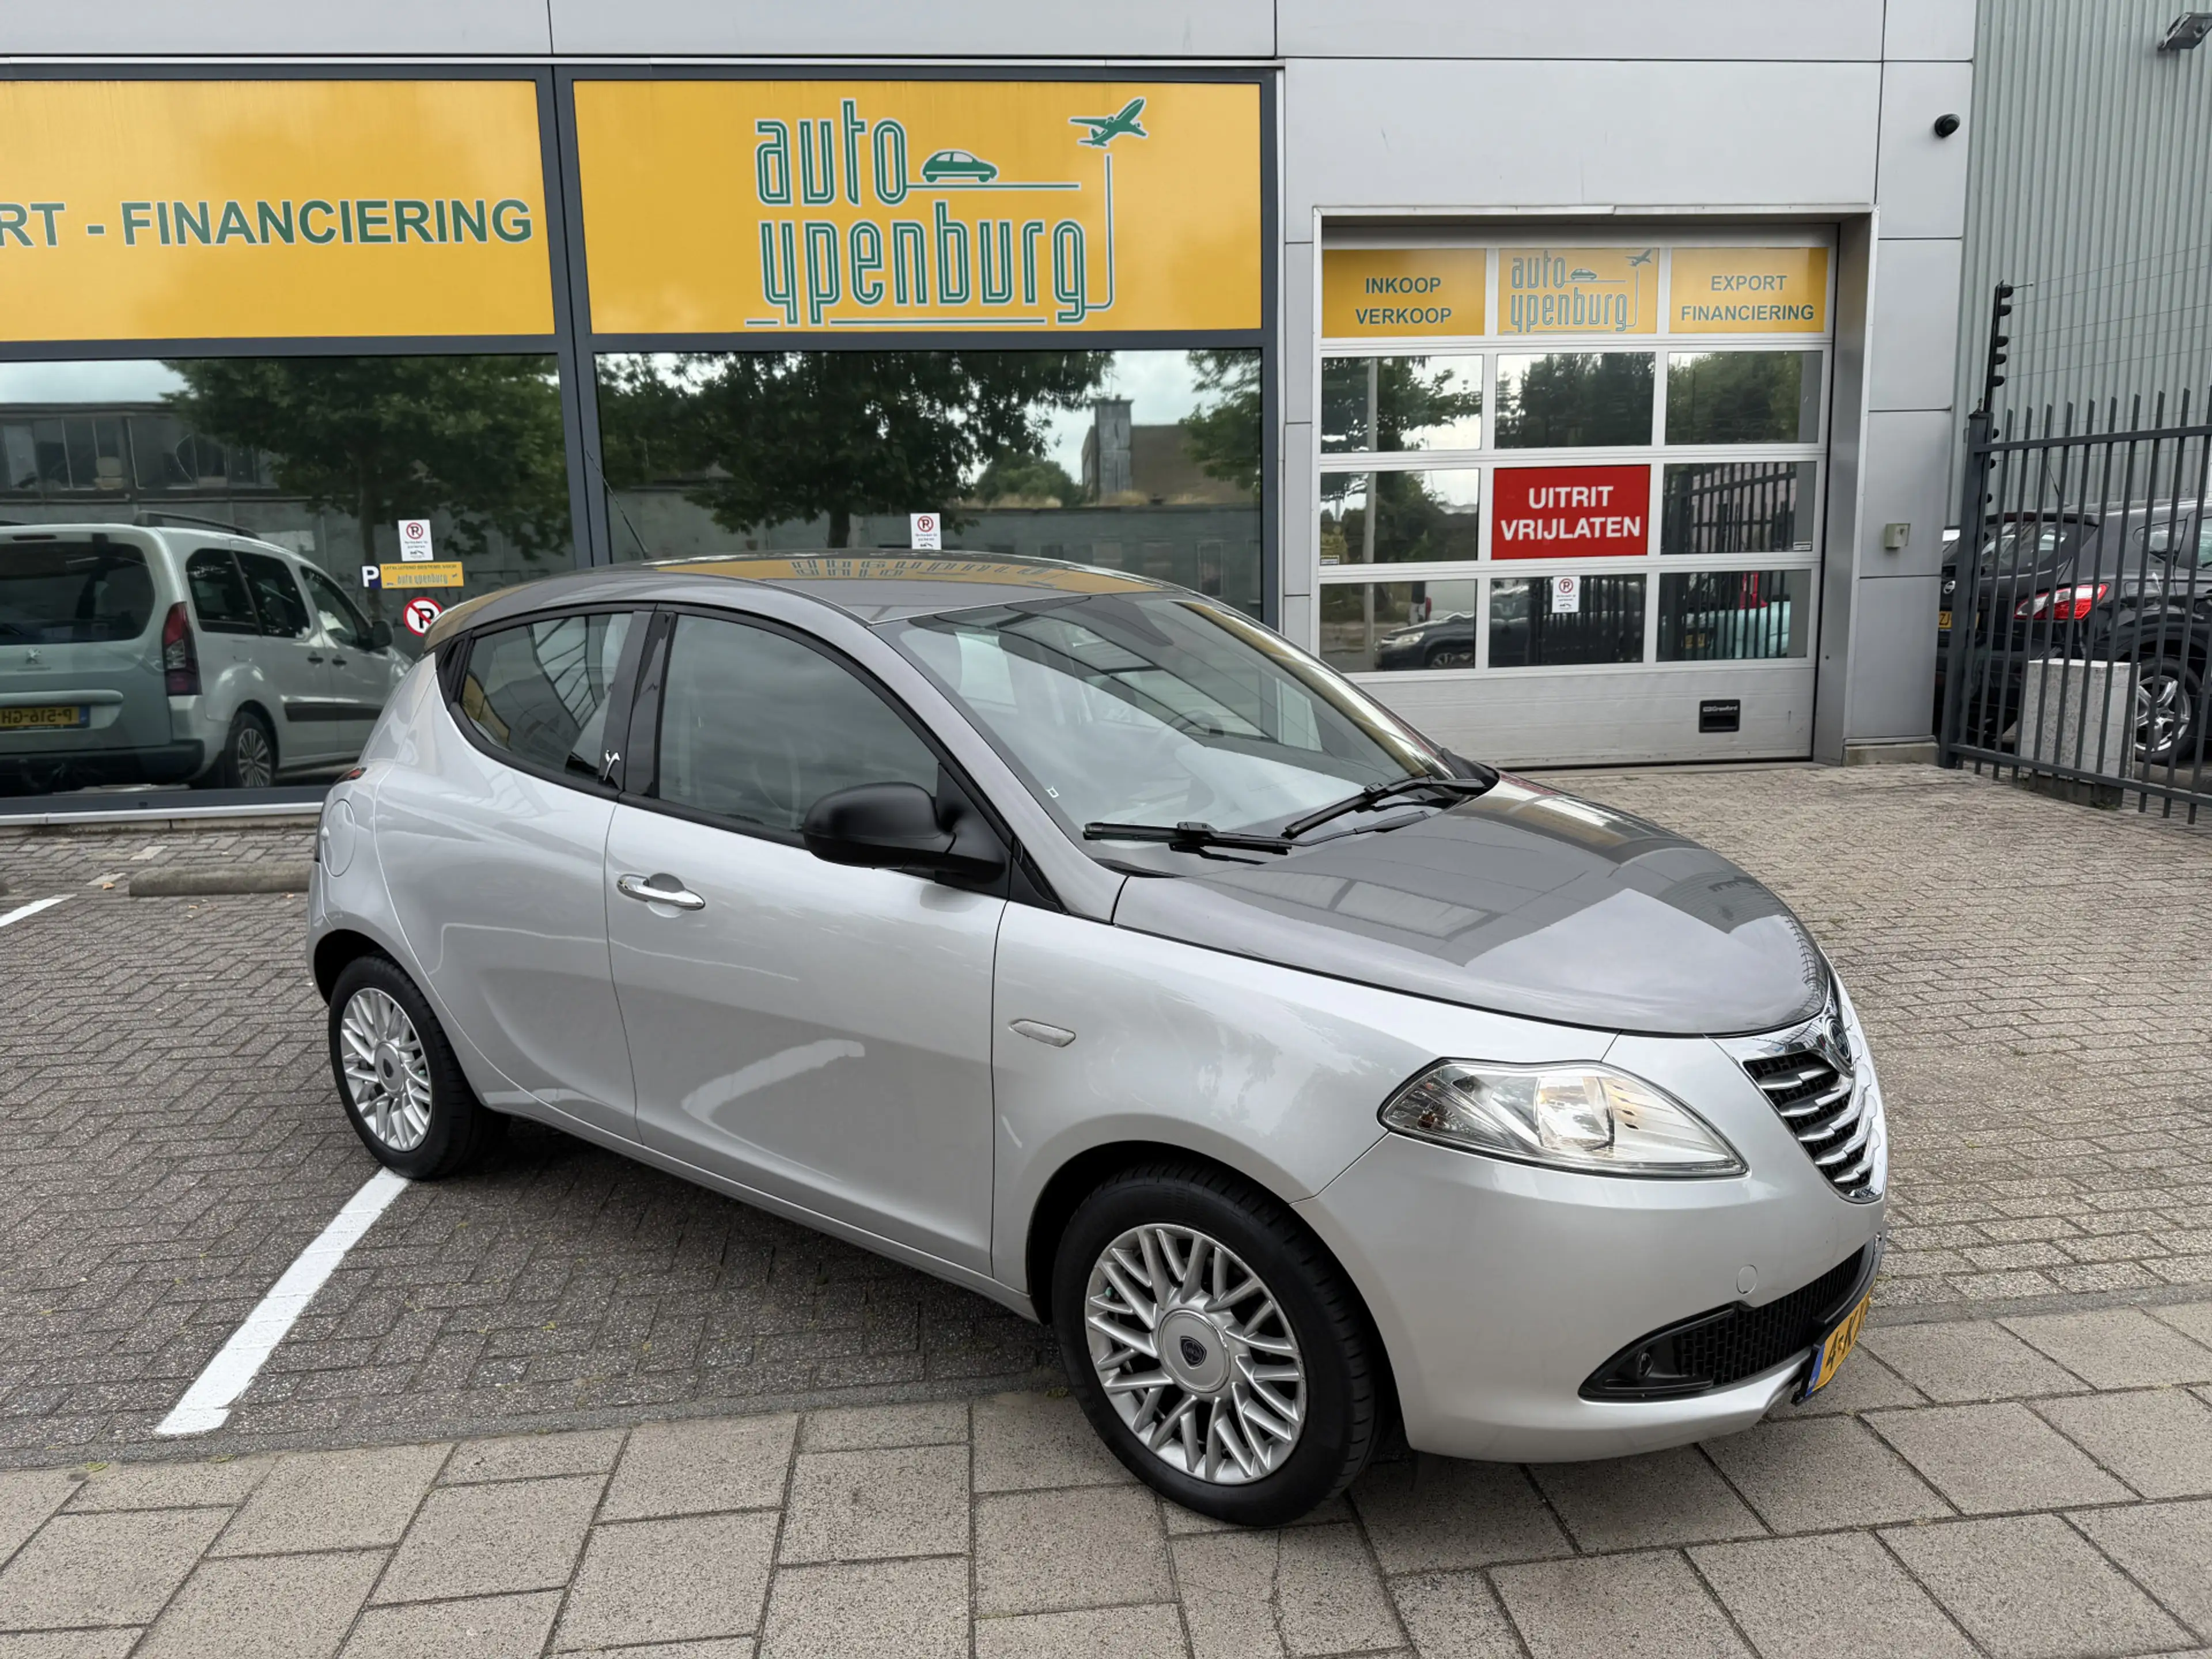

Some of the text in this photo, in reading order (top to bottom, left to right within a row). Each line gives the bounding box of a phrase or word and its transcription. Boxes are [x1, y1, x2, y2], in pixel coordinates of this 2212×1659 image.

[755, 98, 908, 207] auto
[120, 199, 533, 246] FINANCIERING
[757, 200, 1086, 326] ypenburg
[1511, 249, 1567, 289] auto
[1365, 276, 1442, 294] INKOOP
[1710, 274, 1788, 291] EXPORT
[1355, 306, 1452, 325] VERKOOP
[1509, 286, 1628, 332] ypenburg
[1680, 304, 1815, 321] FINANCIERING
[1528, 485, 1614, 509] UITRIT
[1500, 516, 1641, 541] VRIJLATEN
